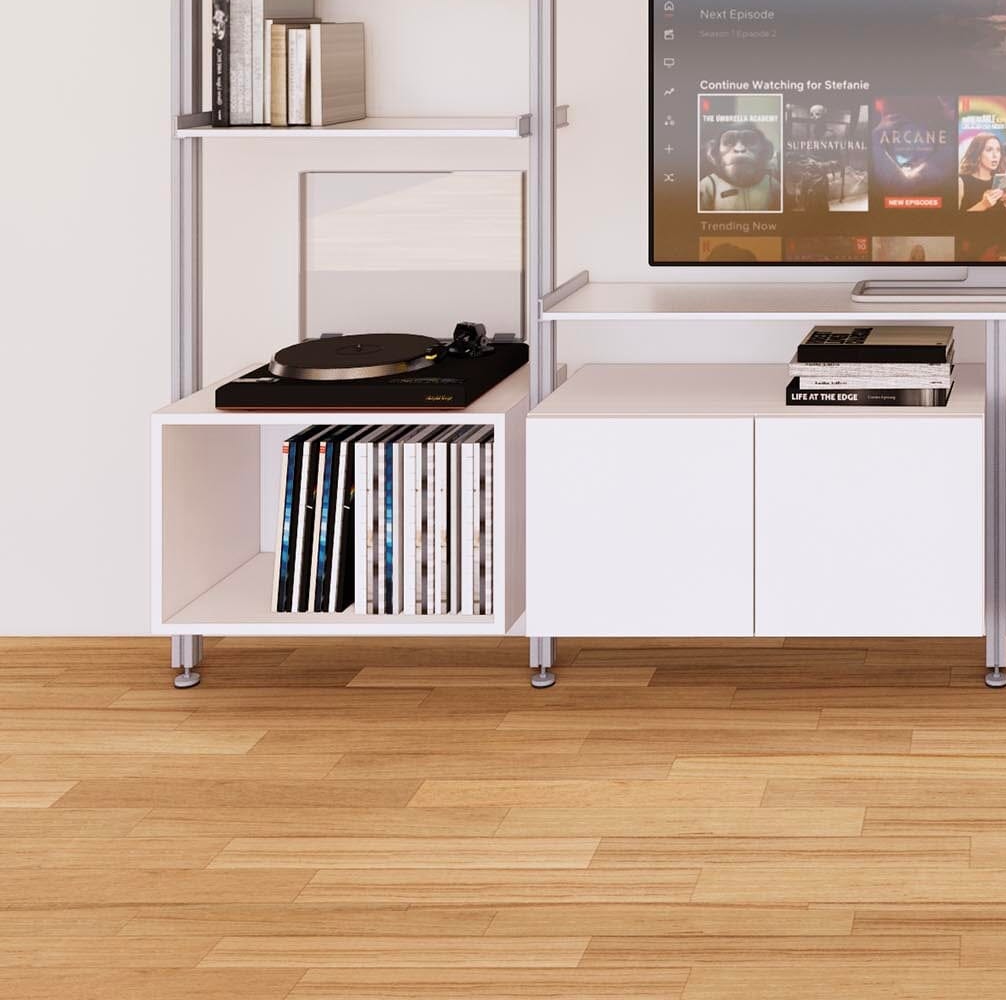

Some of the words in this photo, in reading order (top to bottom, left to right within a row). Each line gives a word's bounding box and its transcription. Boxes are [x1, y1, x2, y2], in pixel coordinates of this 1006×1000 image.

[700, 9, 726, 20] Next
[730, 8, 775, 21] Episode
[700, 80, 749, 90] Continue
[752, 80, 804, 92] Watching
[807, 80, 822, 90] for
[824, 80, 870, 90] Stefanie
[880, 130, 947, 144] ARCANE
[787, 140, 868, 150] SUPERNATURAL
[700, 221, 750, 232] Trending
[752, 222, 776, 231] Now
